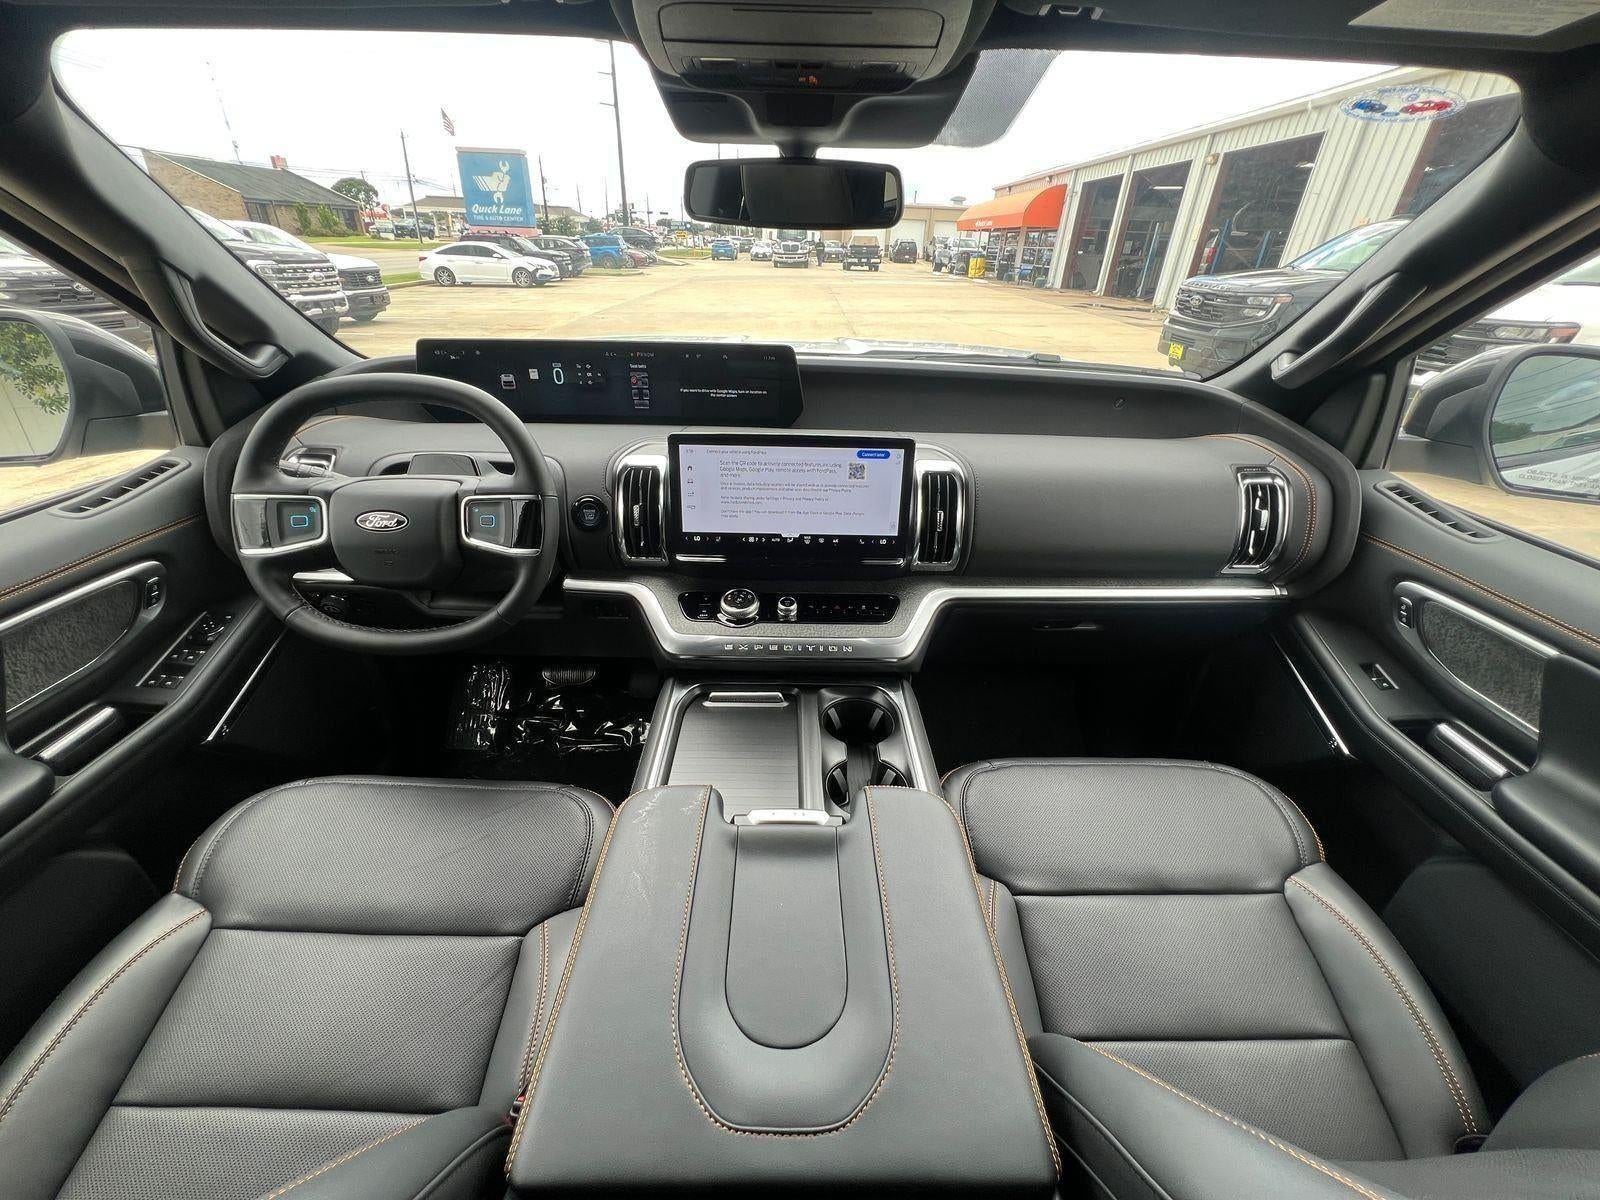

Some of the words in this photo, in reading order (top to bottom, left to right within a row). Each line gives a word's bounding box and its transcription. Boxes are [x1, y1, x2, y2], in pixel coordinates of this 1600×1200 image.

[472, 203, 498, 214] Quick
[499, 204, 522, 215] Lane
[365, 512, 398, 528] Ford
[724, 643, 853, 653] EXPEDITION
